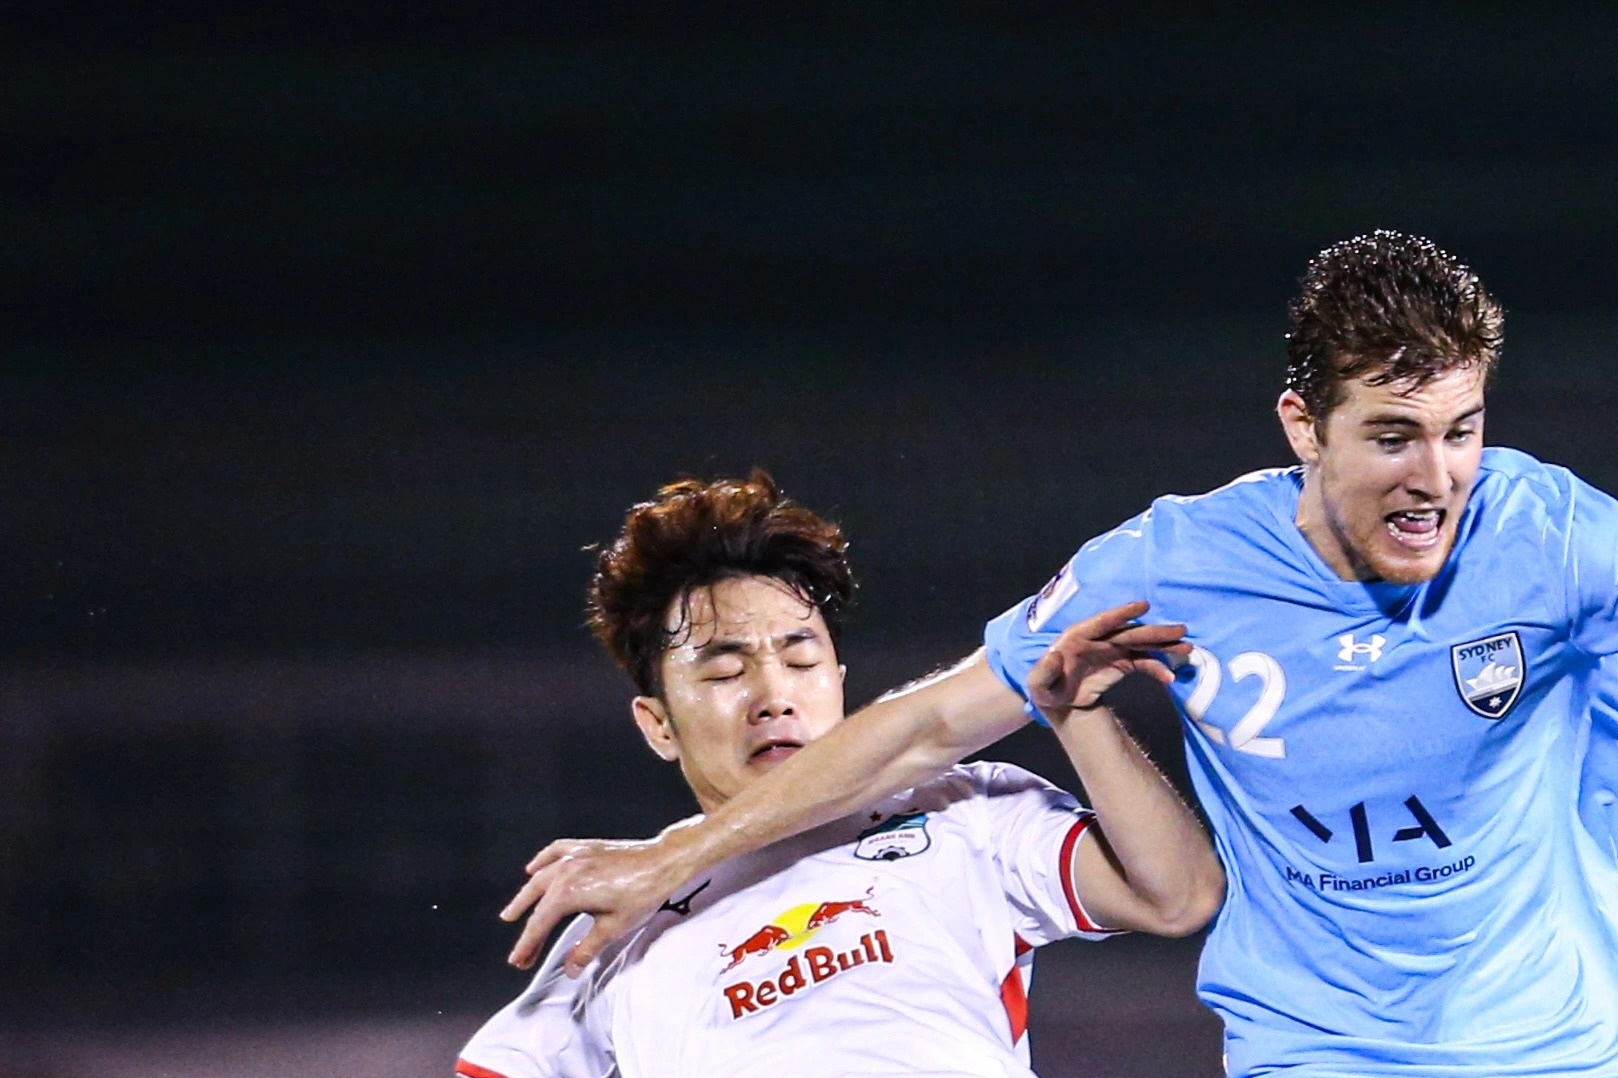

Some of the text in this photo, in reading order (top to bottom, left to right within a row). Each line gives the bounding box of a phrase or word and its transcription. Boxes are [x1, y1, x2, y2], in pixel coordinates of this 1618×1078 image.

[1459, 637, 1512, 661] SYDNEY
[1481, 653, 1496, 664] FC
[1173, 644, 1287, 760] 22
[1286, 855, 1476, 892] MA Financial Group
[723, 929, 894, 1020] Red Bull
